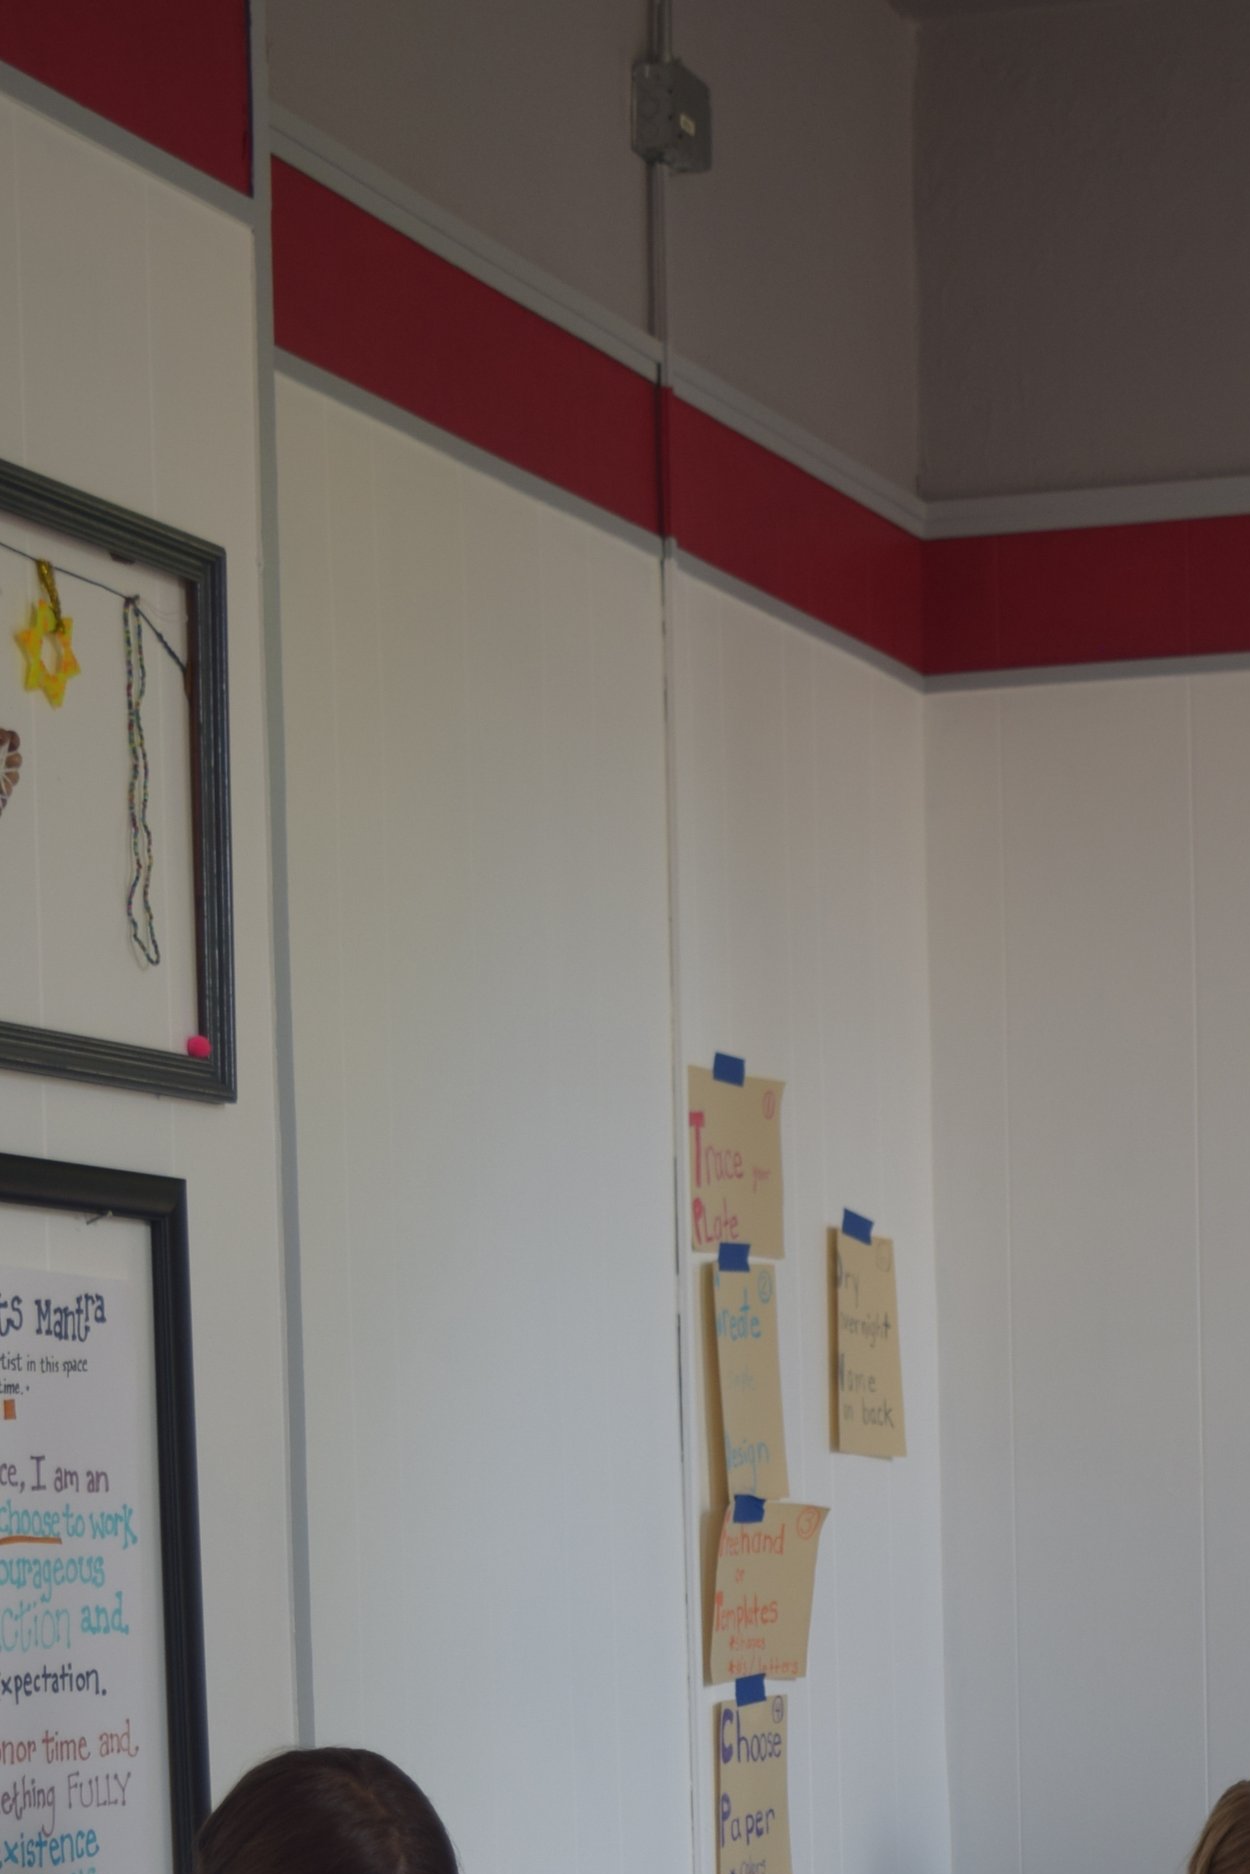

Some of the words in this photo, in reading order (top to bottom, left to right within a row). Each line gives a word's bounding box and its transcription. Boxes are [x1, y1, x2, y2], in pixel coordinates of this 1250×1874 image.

[689, 1111, 745, 1187] Trace
[34, 1293, 107, 1343] Mantra
[26, 1354, 37, 1373] in
[40, 1355, 60, 1374] this
[62, 1359, 89, 1379] space
[861, 1398, 895, 1429] back
[30, 1454, 47, 1492] I
[54, 1466, 79, 1493] am
[86, 1469, 109, 1493] an
[62, 1503, 86, 1538] to
[88, 1502, 138, 1550] work
[0, 1739, 37, 1765] nor
[41, 1729, 91, 1764] time
[99, 1718, 140, 1758] and
[720, 1708, 783, 1764] Choose
[66, 1770, 131, 1810] FULLY
[720, 1792, 776, 1848] Paper
[0, 1828, 100, 1868] xistence
